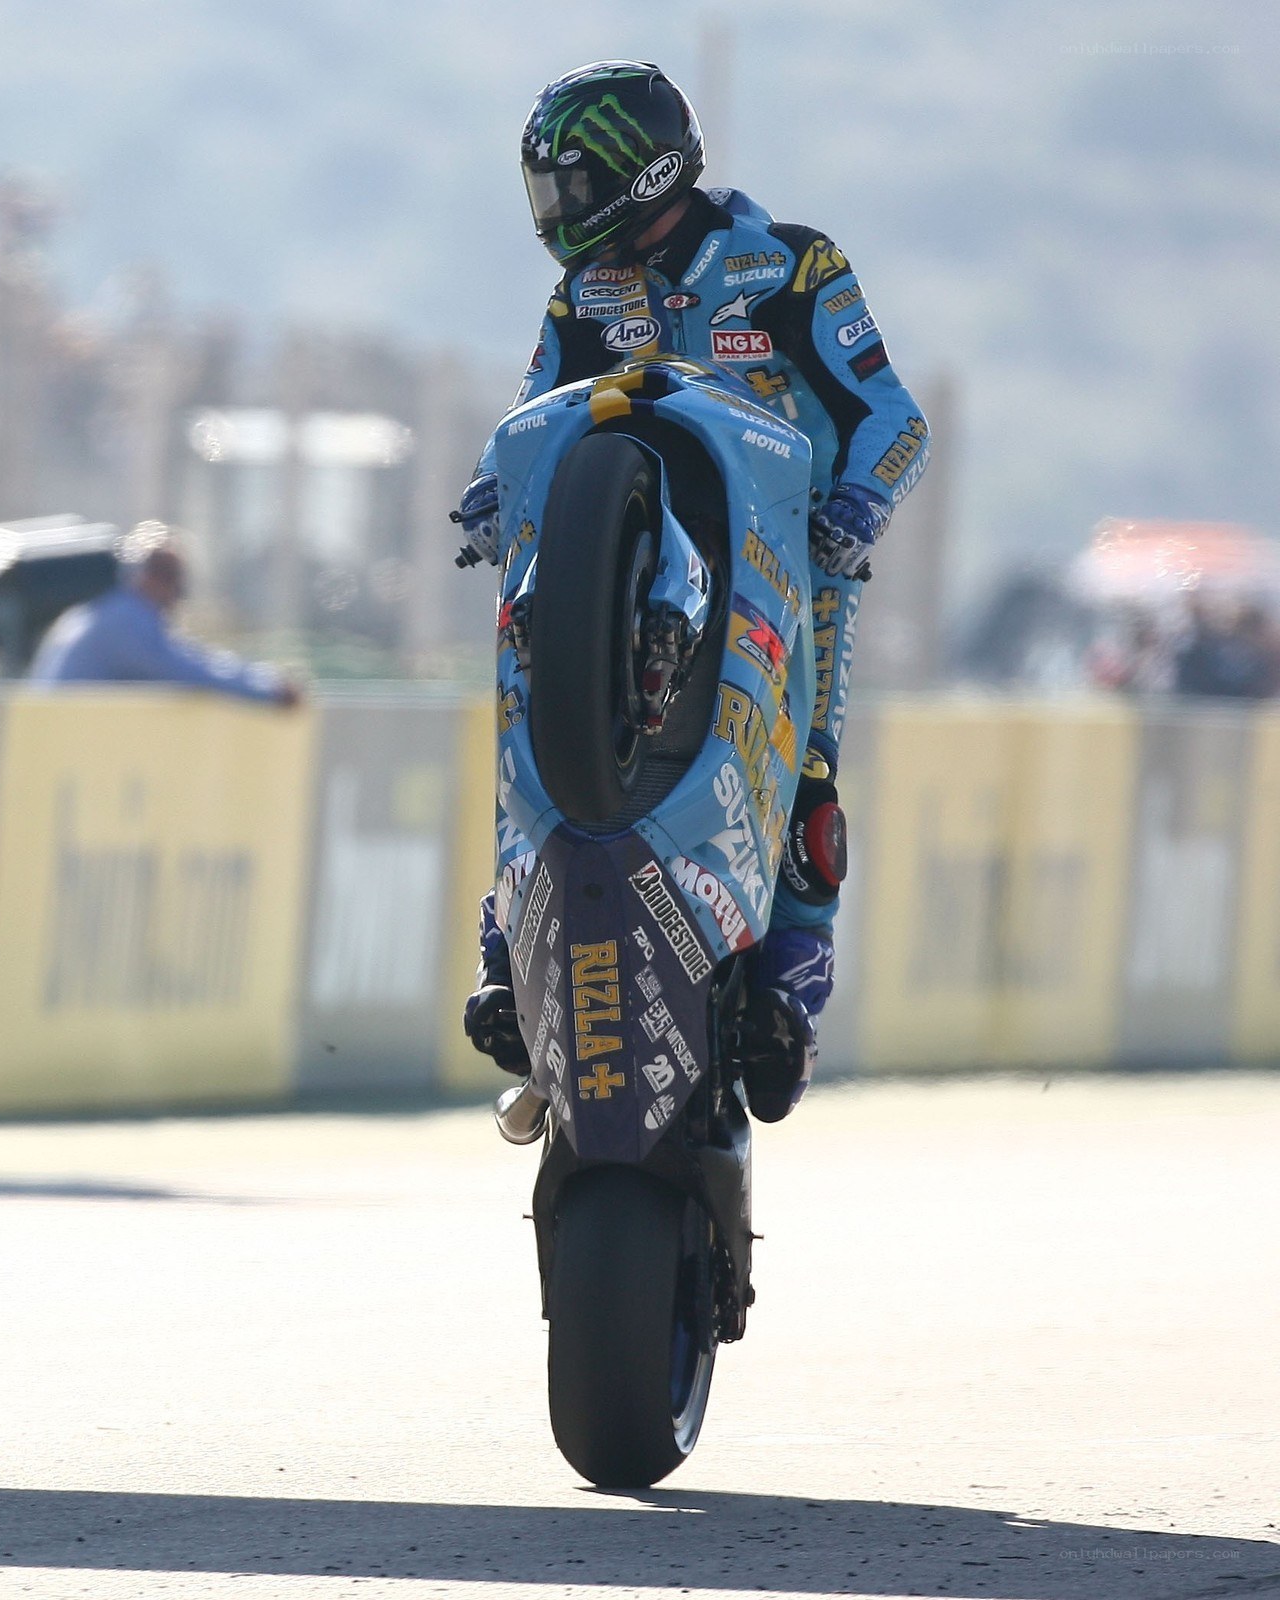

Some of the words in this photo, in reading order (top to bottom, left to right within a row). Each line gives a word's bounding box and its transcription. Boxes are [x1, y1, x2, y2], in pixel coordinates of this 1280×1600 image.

[640, 157, 677, 195] Arai
[582, 194, 630, 229] MONSTER
[582, 268, 635, 283] MOTUL
[684, 239, 720, 286] SUZUKI
[581, 283, 641, 298] CRESCENT
[724, 267, 785, 287] SUZUKI
[578, 298, 647, 318] BRIDGESTONE
[607, 319, 653, 347] Arai
[716, 335, 766, 351] NGK
[508, 413, 548, 436] MOTUL
[742, 429, 791, 459] MOTUL
[670, 855, 748, 951] MOTUL
[628, 860, 712, 984] BRIDGESTONE
